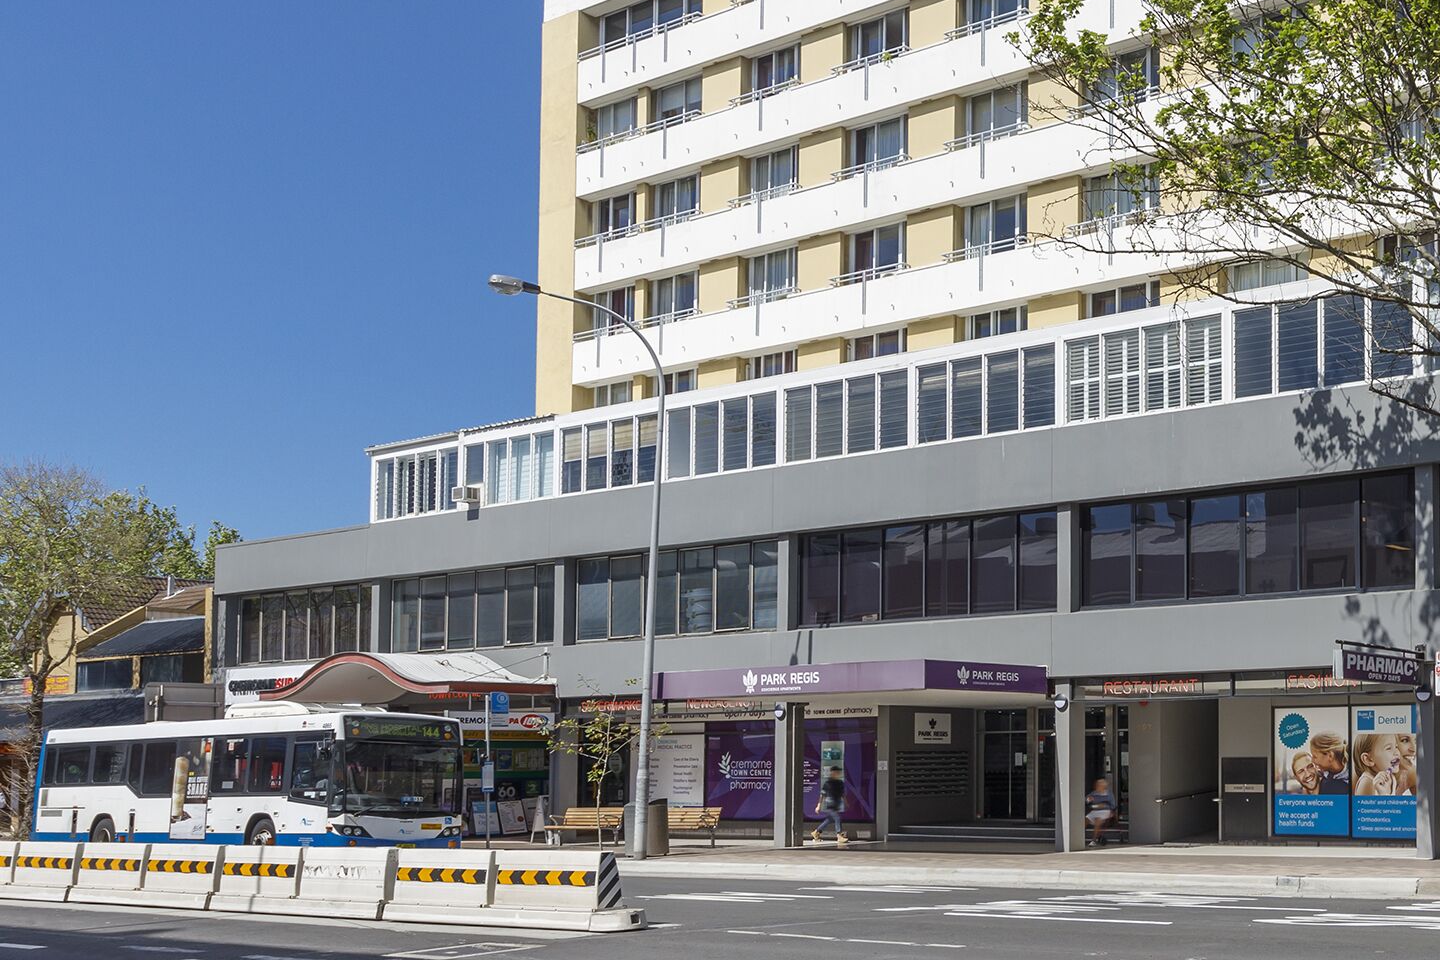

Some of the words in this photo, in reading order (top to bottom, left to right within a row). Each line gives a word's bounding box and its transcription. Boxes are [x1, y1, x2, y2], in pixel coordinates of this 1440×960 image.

[760, 673, 786, 686] PARK
[790, 672, 820, 684] REGIS
[972, 670, 994, 680] PARK
[996, 672, 1020, 682] REGIS
[1368, 672, 1382, 680] OPEN
[1104, 679, 1198, 694] RESTAURANT
[1378, 716, 1406, 724] Dental
[422, 727, 440, 737] 144
[1283, 728, 1306, 739] Saturdays
[730, 760, 772, 769] cremorne
[730, 780, 771, 791] pharmacy
[1279, 799, 1306, 807] Everyone
